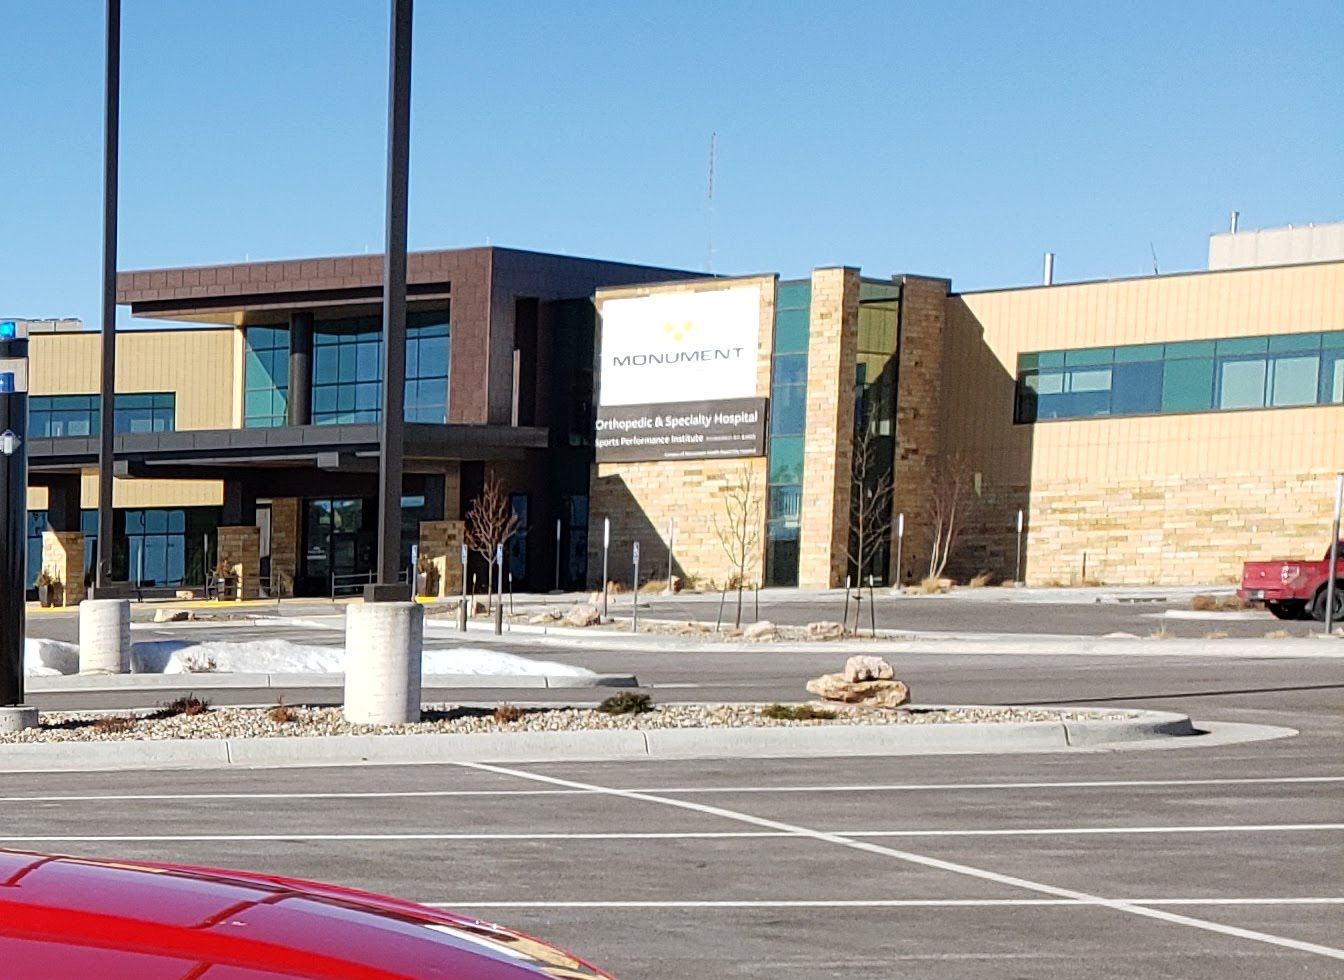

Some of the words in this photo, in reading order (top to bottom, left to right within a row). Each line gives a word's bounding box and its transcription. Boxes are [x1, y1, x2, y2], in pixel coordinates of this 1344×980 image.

[613, 348, 744, 366] MONUMENT
[596, 416, 653, 432] Orthopedic
[665, 413, 712, 429] Specialty
[714, 410, 758, 427] Hospital
[620, 435, 670, 446] Performance
[671, 433, 704, 443] Institute
